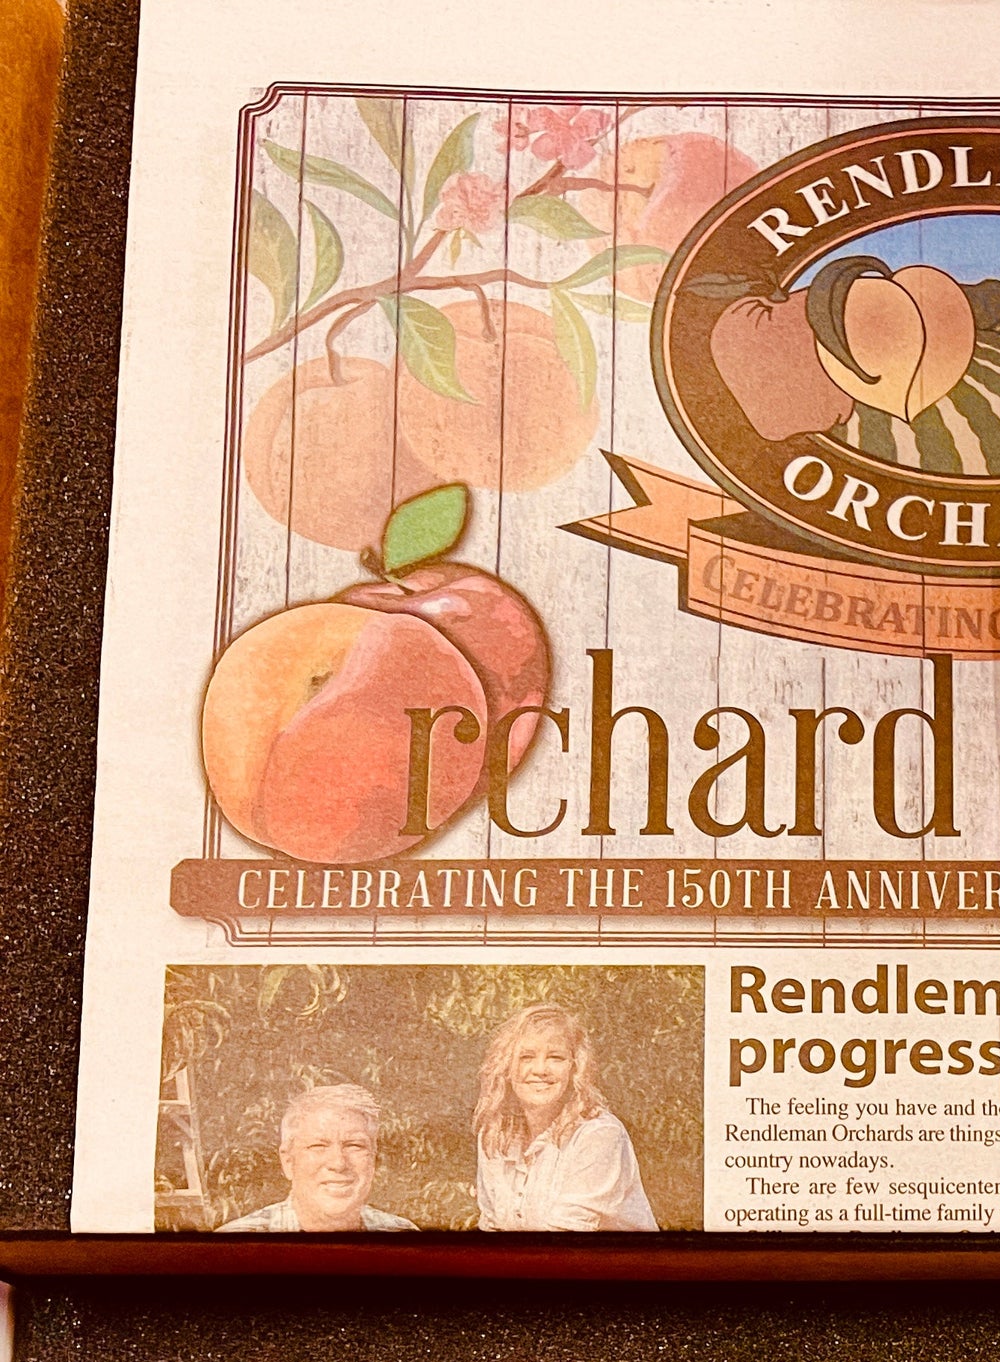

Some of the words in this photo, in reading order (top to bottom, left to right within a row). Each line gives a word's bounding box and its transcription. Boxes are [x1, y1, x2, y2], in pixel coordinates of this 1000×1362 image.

[399, 648, 962, 839] rchard
[237, 868, 539, 909] CELEBRATING
[559, 868, 645, 909] THE
[665, 869, 792, 909] 150TH
[745, 1097, 781, 1115] The
[787, 1097, 849, 1121] feeling
[855, 1103, 889, 1121] you
[895, 1098, 937, 1116] have
[943, 1098, 975, 1116] and
[725, 1123, 827, 1142] Rendleman
[831, 1123, 914, 1142] Orchards
[918, 1129, 945, 1142] are
[724, 1153, 793, 1173] country
[799, 1150, 894, 1174] nowadays.
[745, 1177, 800, 1195] There
[808, 1182, 837, 1195] are
[846, 1176, 880, 1195] few
[724, 1203, 810, 1227] operating
[814, 1208, 833, 1221] as
[838, 1208, 849, 1221] a
[854, 1203, 932, 1222] full-time
[937, 1203, 995, 1227] family
